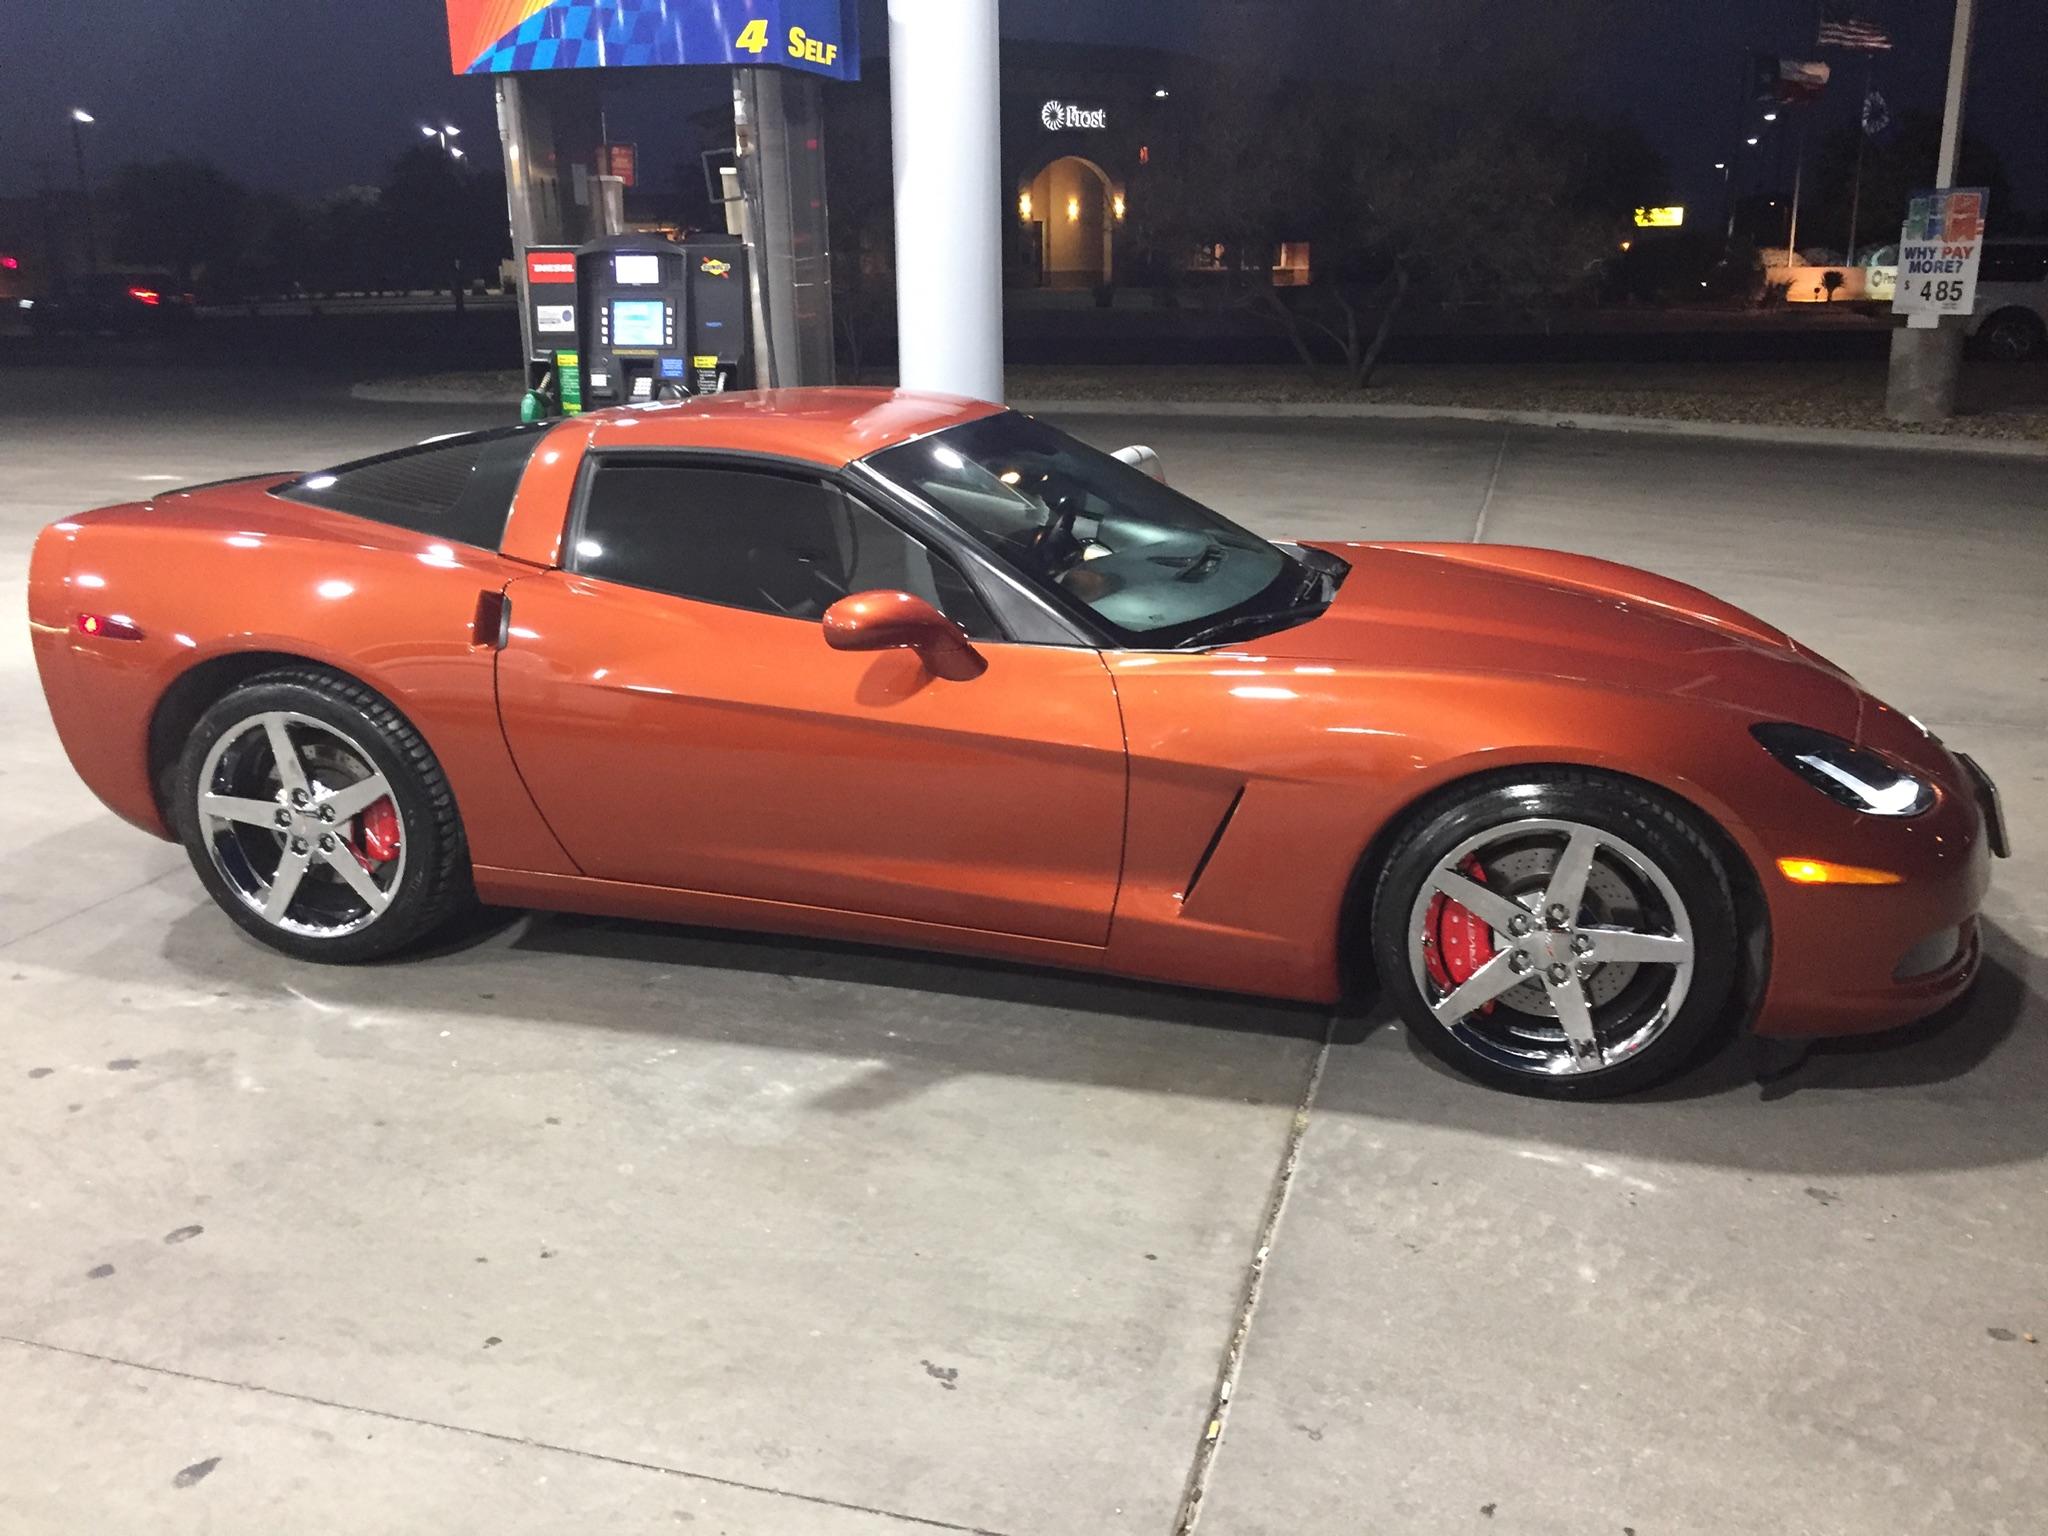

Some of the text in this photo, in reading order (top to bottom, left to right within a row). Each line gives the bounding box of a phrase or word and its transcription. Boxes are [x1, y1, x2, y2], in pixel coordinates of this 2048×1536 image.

[735, 19, 768, 53] 4
[1065, 105, 1106, 128] Frost
[1905, 247, 1974, 260] WHY PAY
[1909, 261, 1963, 274] MORE?
